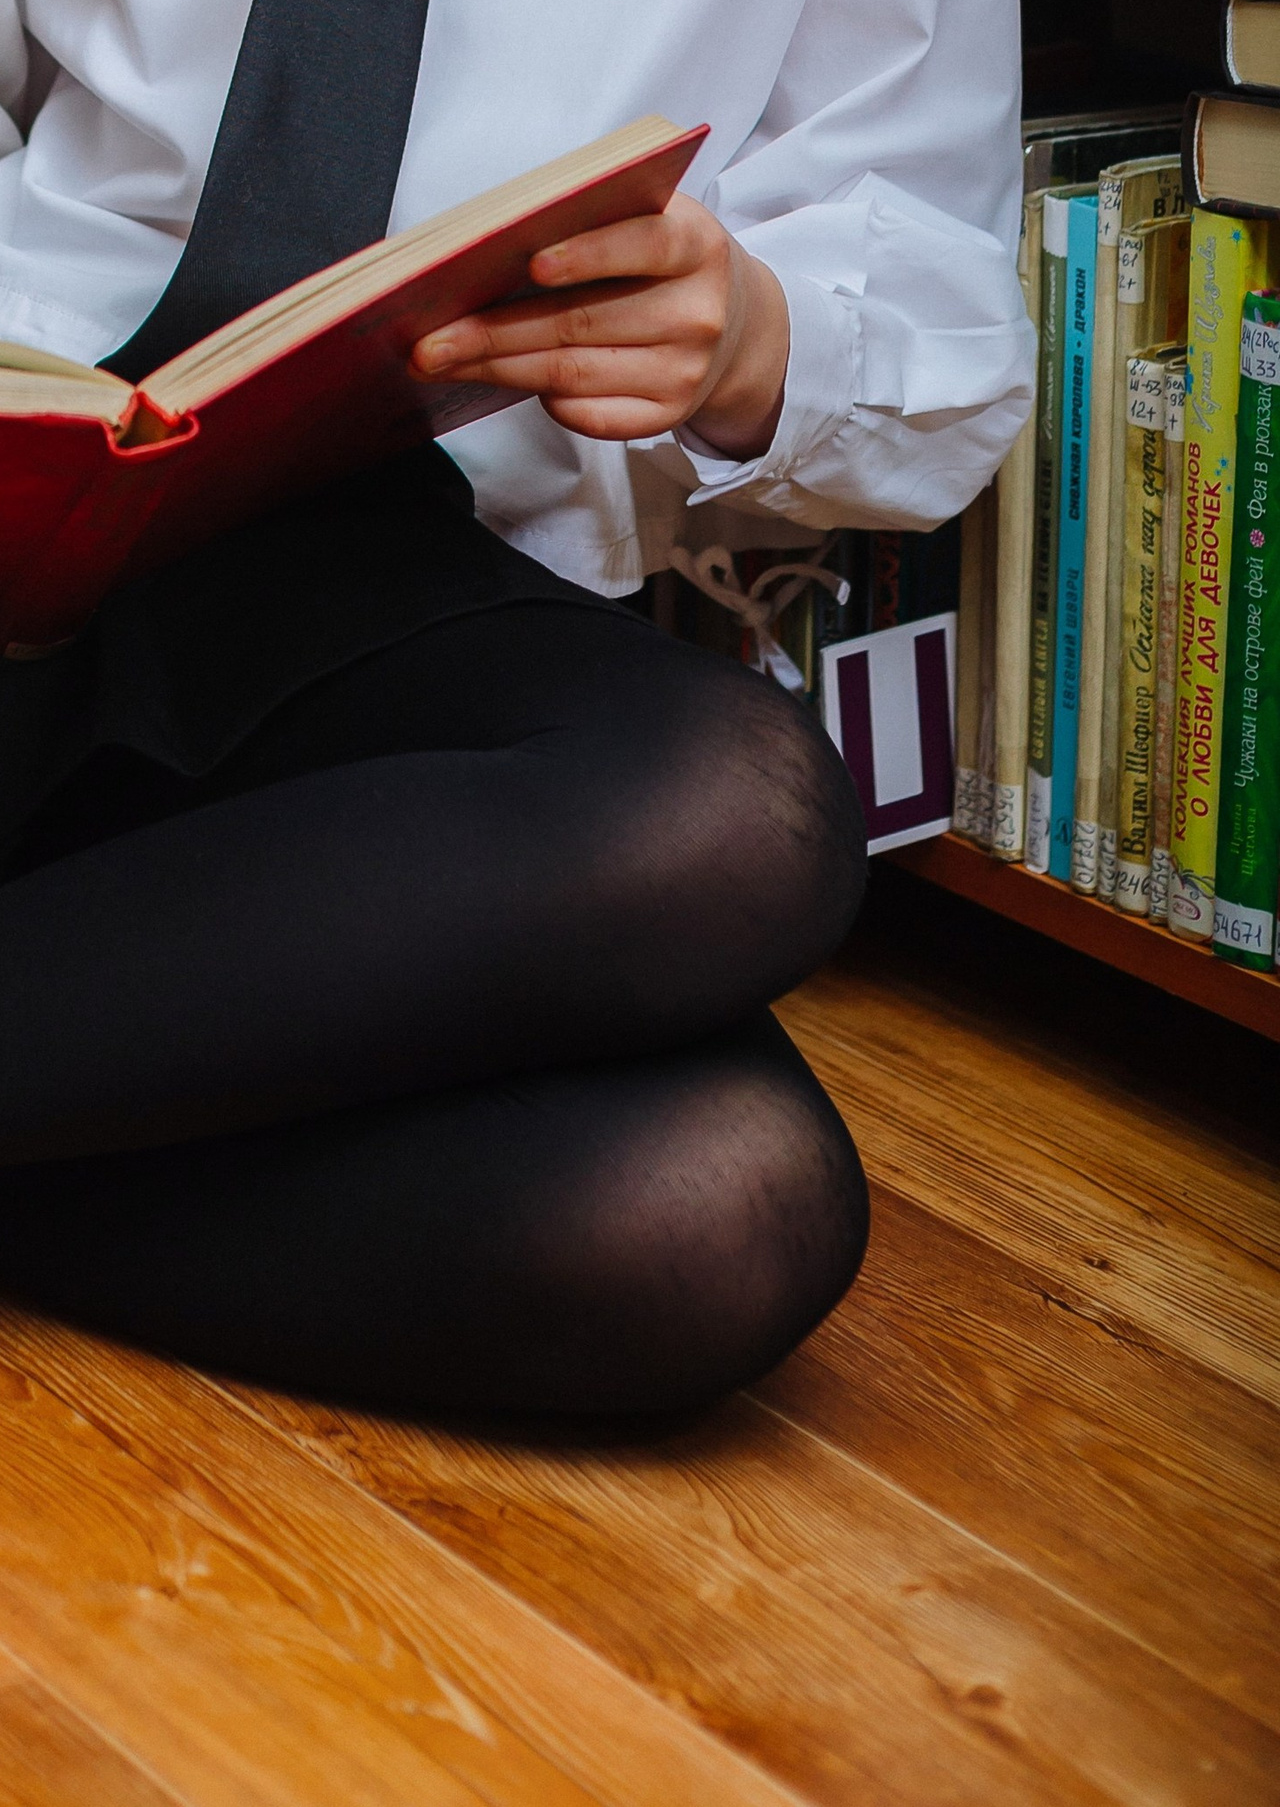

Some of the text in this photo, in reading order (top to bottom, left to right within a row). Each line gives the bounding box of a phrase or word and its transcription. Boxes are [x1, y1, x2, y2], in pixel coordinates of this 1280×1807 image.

[1074, 267, 1087, 335] ДРАКОН
[1071, 354, 1086, 439] КОРОЛЕВА
[1130, 400, 1158, 423] 12+
[1068, 443, 1083, 521] СНЕЖНАЯ
[1246, 478, 1268, 520] Фея
[1255, 461, 1270, 472] в
[1173, 442, 1202, 842] КОЛЛЕКЦИЯ ЛУЧШИХ РОМАНОВ
[1190, 480, 1222, 817] О ЛЮБВИ ДЛЯ ДЕВОЧЕК
[1233, 557, 1268, 788] Чужаки на острове фей
[1121, 685, 1154, 857] Вадим Шефнер
[1214, 912, 1263, 948] 54671
